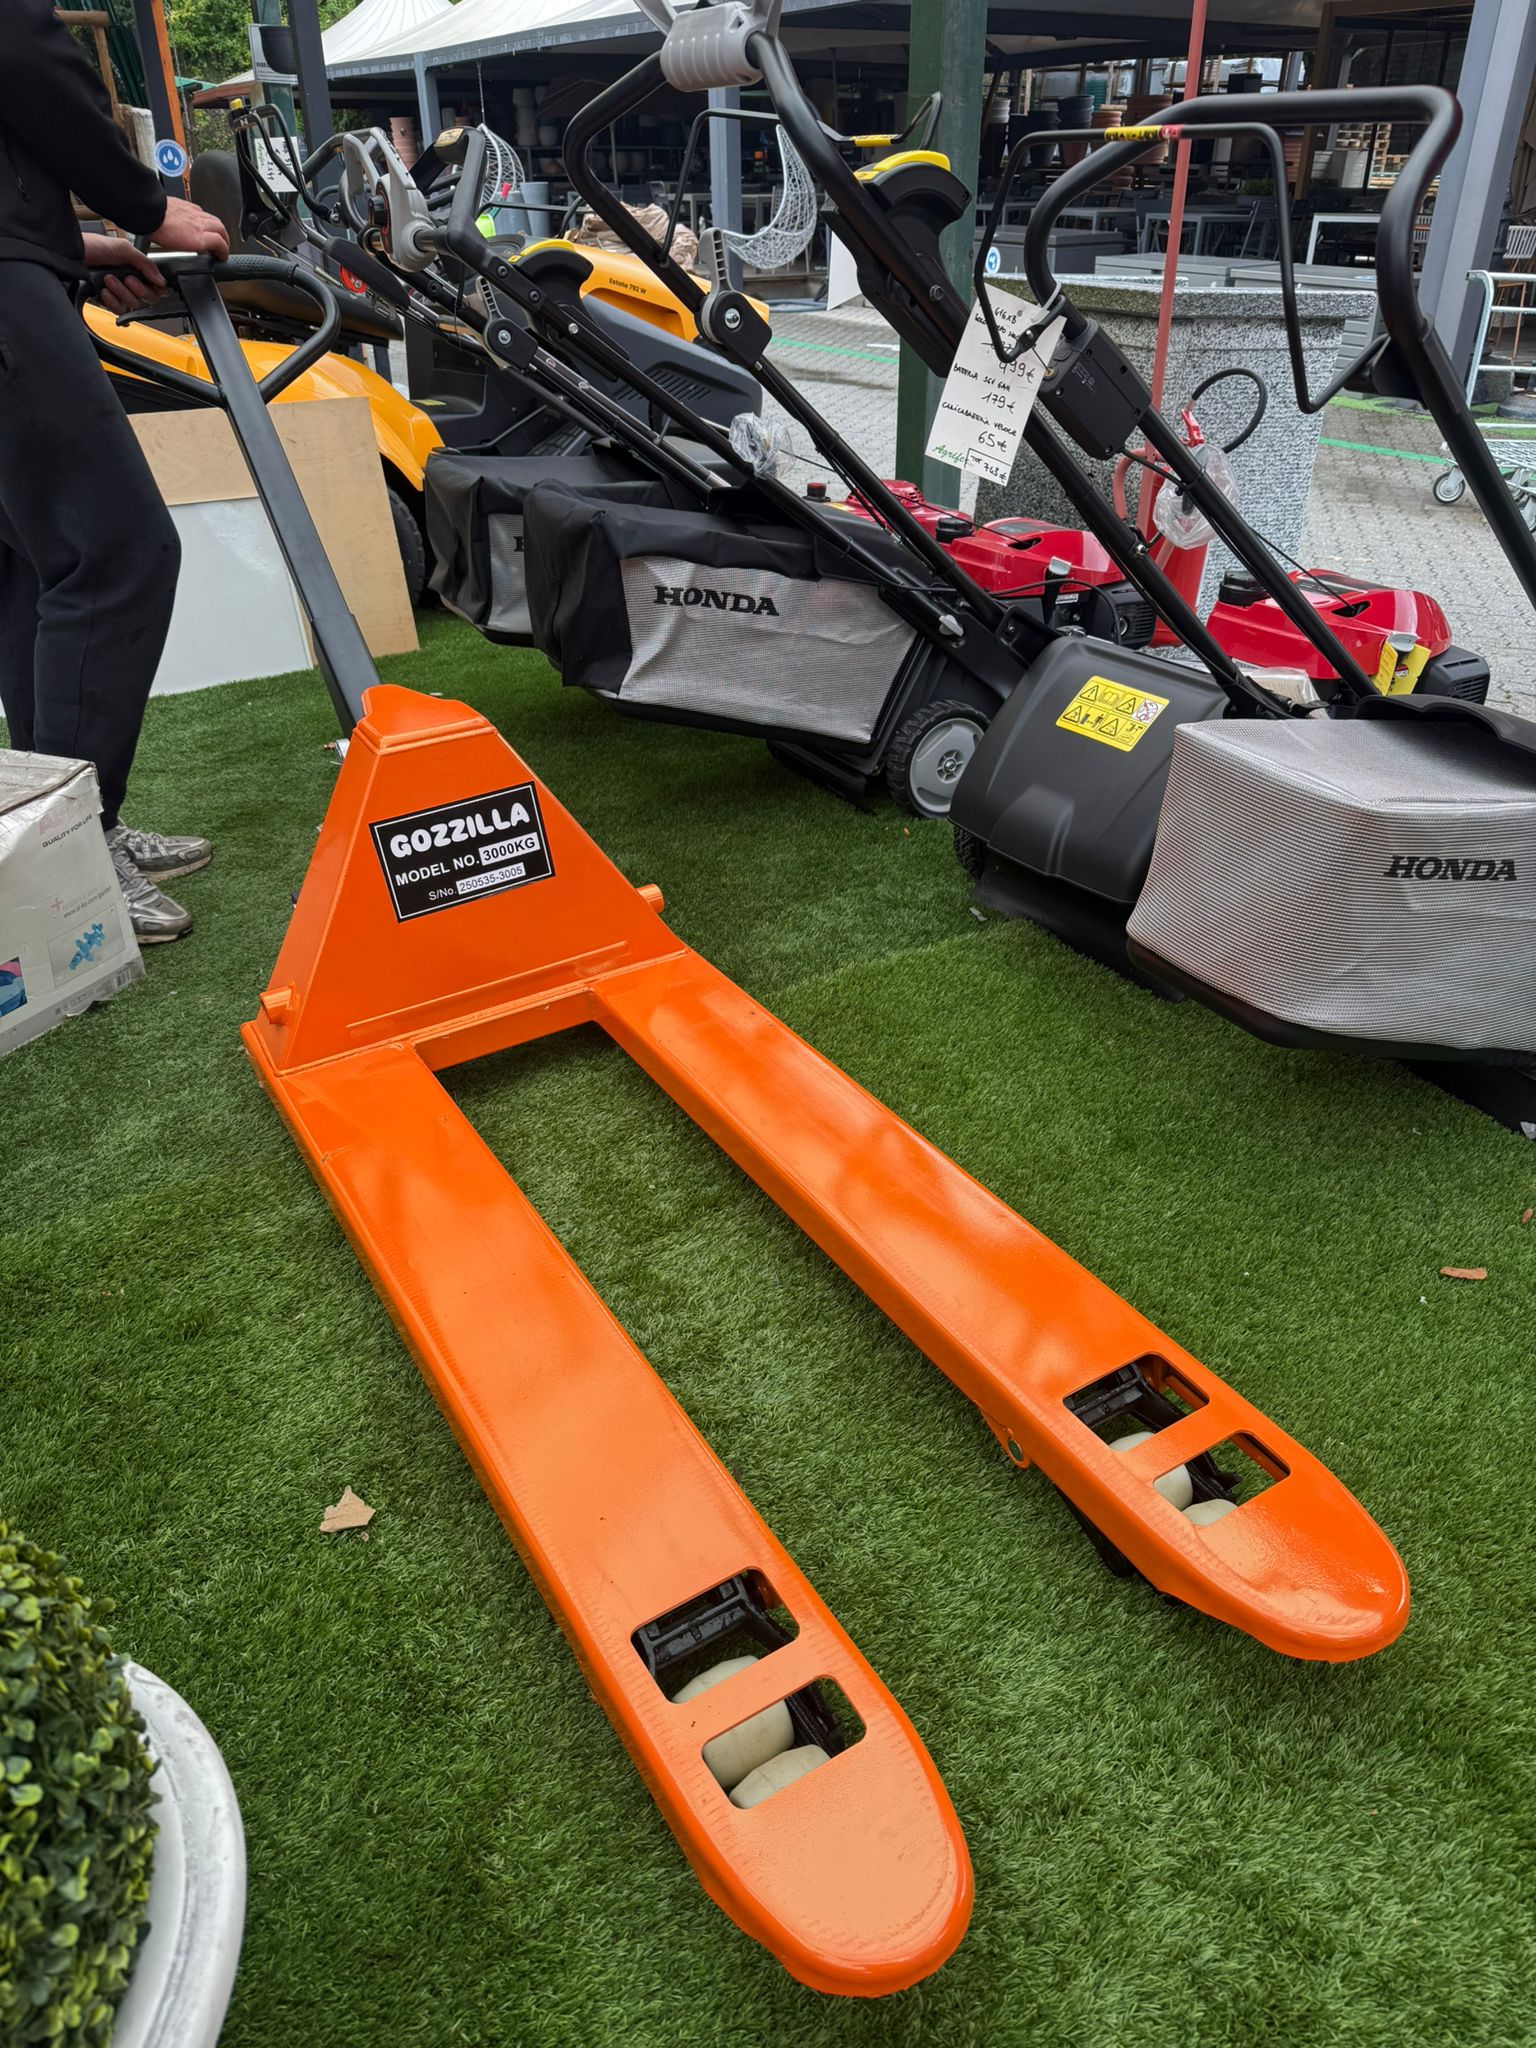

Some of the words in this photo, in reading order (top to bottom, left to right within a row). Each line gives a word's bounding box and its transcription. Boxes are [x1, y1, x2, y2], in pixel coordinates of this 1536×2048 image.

[609, 277, 628, 289] Estate
[653, 585, 780, 616] HONDA
[42, 830, 70, 849] QUALITY
[70, 822, 84, 833] FOR
[83, 814, 93, 826] LIFE
[390, 802, 530, 858] GOZZILLA
[395, 862, 450, 887] MODEL
[453, 855, 480, 870] NO.
[482, 836, 536, 862] 3000KG
[1382, 854, 1518, 881] HONDA
[428, 887, 457, 901] S/No.
[459, 865, 523, 893] 250535-3005
